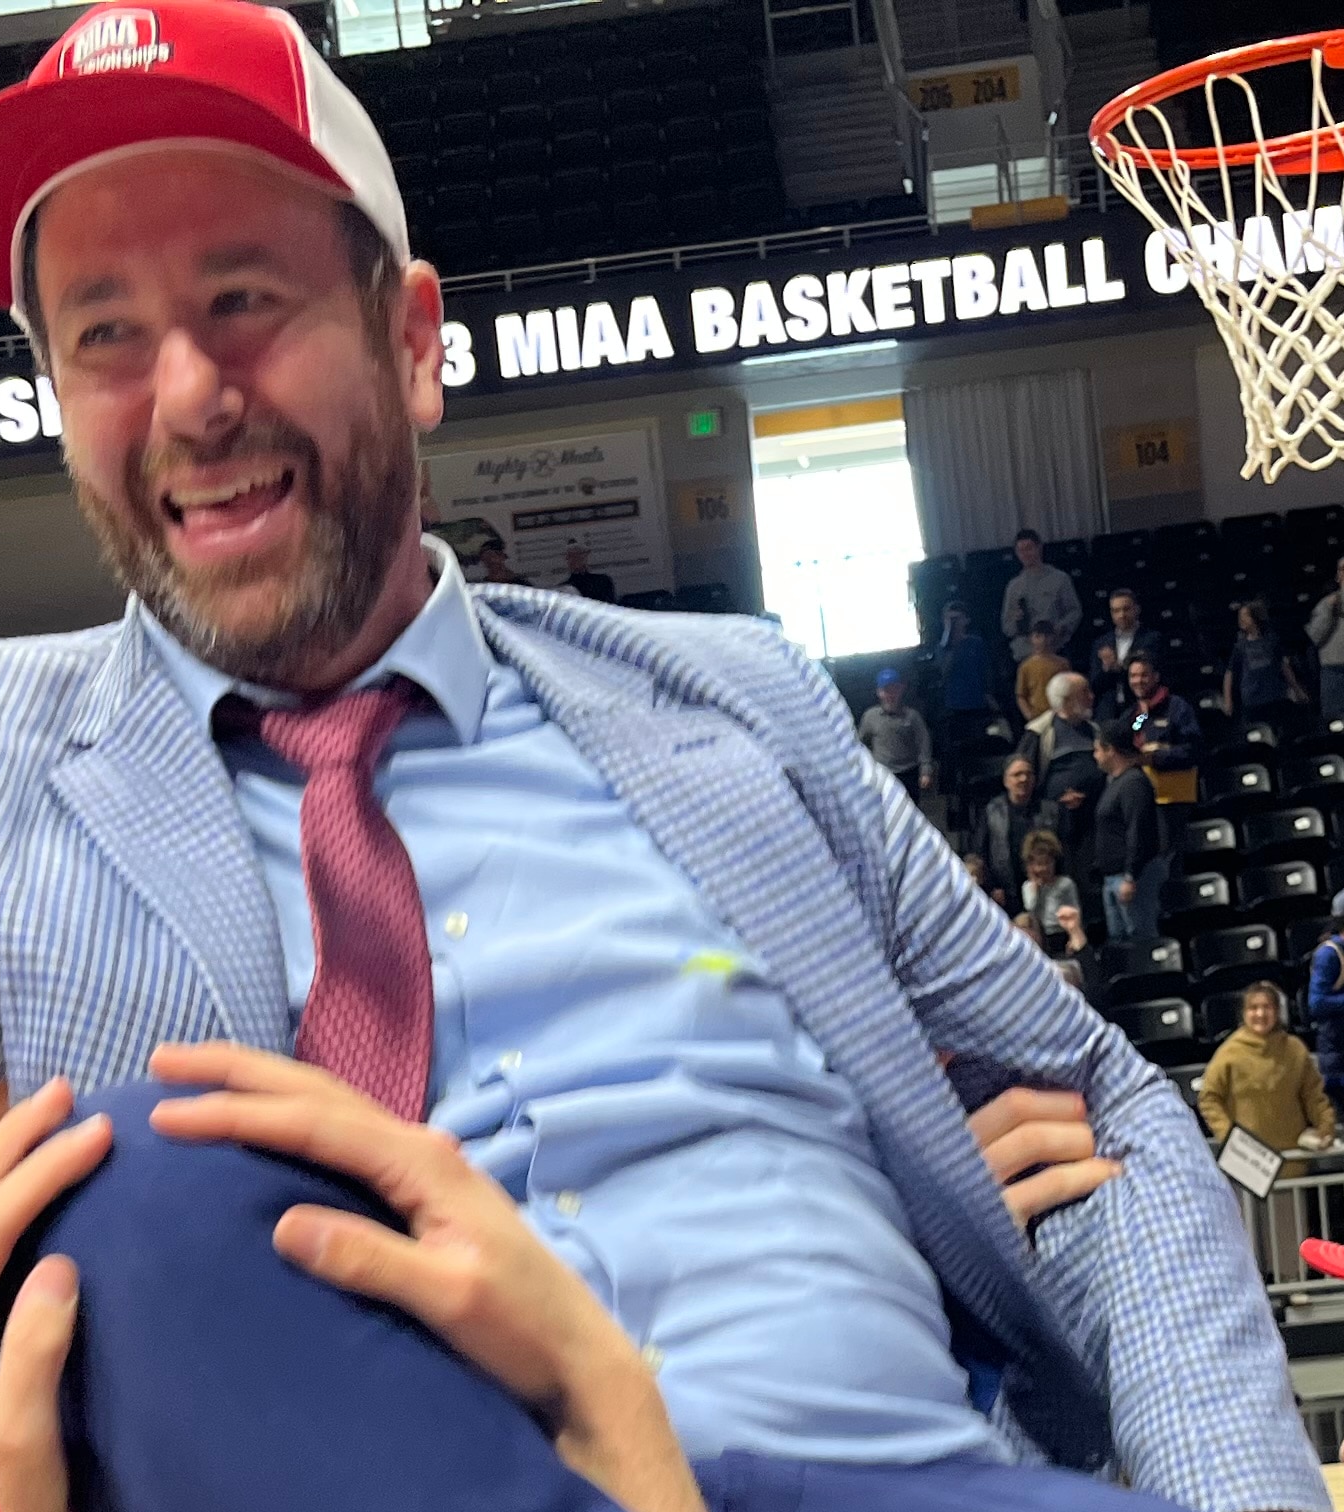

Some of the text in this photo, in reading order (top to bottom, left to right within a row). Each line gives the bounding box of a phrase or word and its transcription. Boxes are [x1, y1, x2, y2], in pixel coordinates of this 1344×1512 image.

[72, 14, 139, 68] MIAA
[495, 296, 674, 378] MIAA
[691, 239, 1125, 352] BASKETBALL
[1135, 440, 1169, 468] 104
